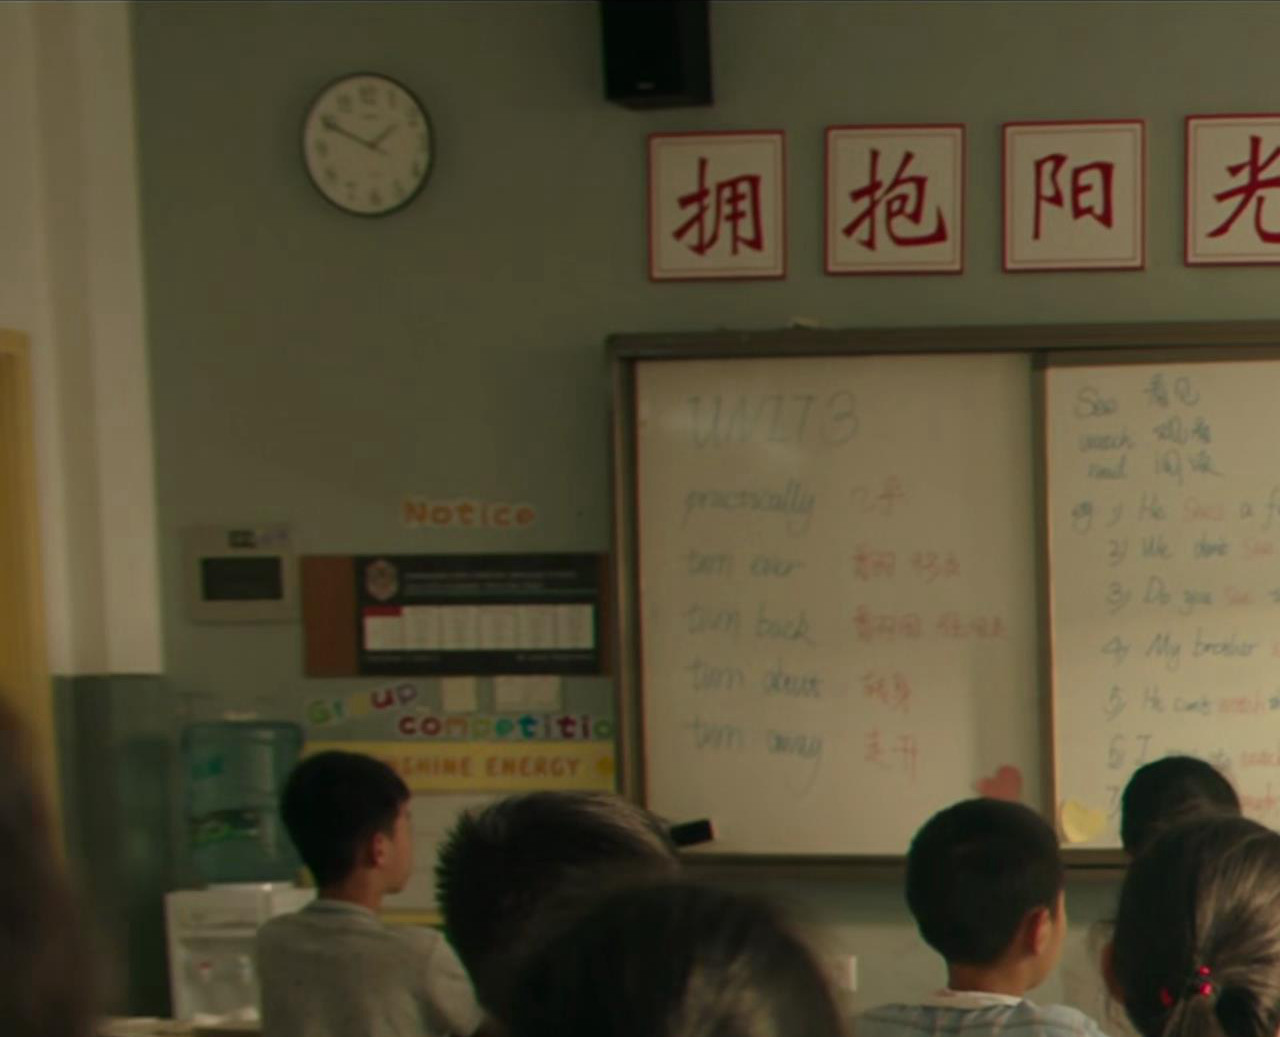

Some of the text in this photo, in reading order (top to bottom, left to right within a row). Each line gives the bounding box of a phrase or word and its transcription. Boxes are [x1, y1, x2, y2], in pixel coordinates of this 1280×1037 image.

[1073, 385, 1119, 419] See
[402, 500, 536, 526] Notice
[681, 478, 814, 539] practically
[1240, 500, 1254, 520] a
[754, 600, 819, 648] back
[1145, 631, 1182, 673] My
[485, 756, 581, 778] ENERGY
